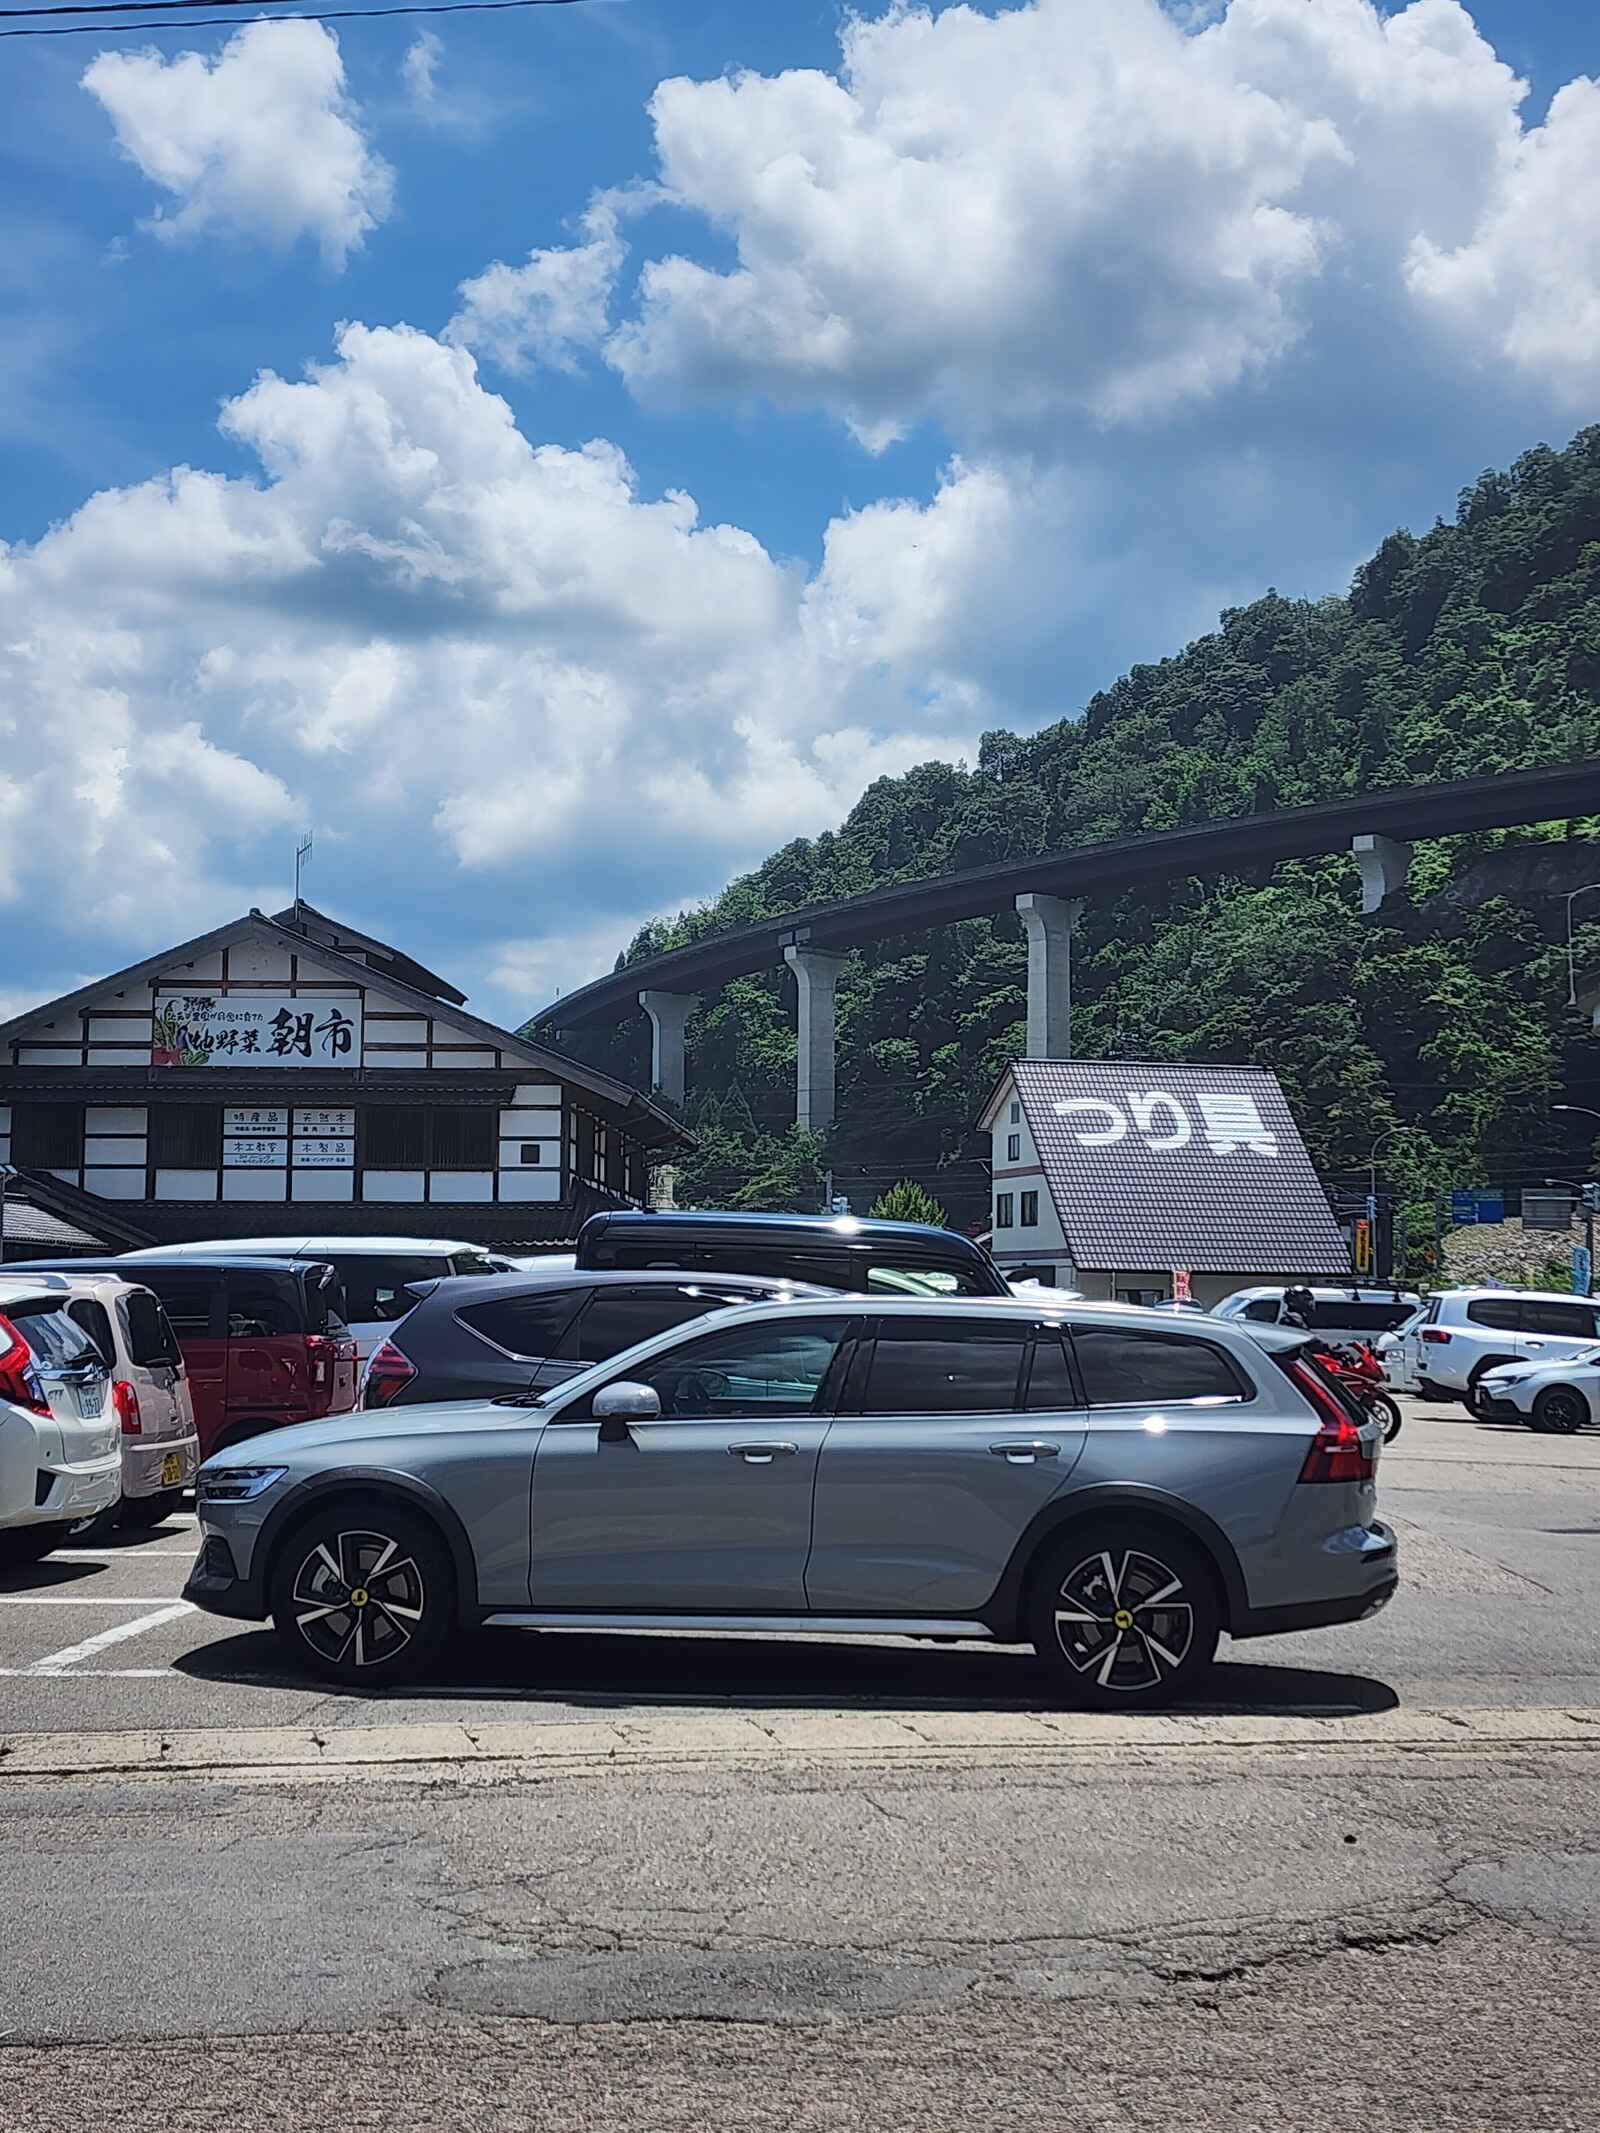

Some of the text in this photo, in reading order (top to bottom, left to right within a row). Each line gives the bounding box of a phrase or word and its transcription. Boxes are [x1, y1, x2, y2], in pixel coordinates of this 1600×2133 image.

[188, 1007, 354, 1060] 地野菜 朝市
[233, 1111, 278, 1122] 特産品
[303, 1111, 346, 1122] 天然木
[1051, 1090, 1279, 1157] つり具
[232, 1142, 278, 1152] 木工教室
[301, 1142, 346, 1153] 木製品
